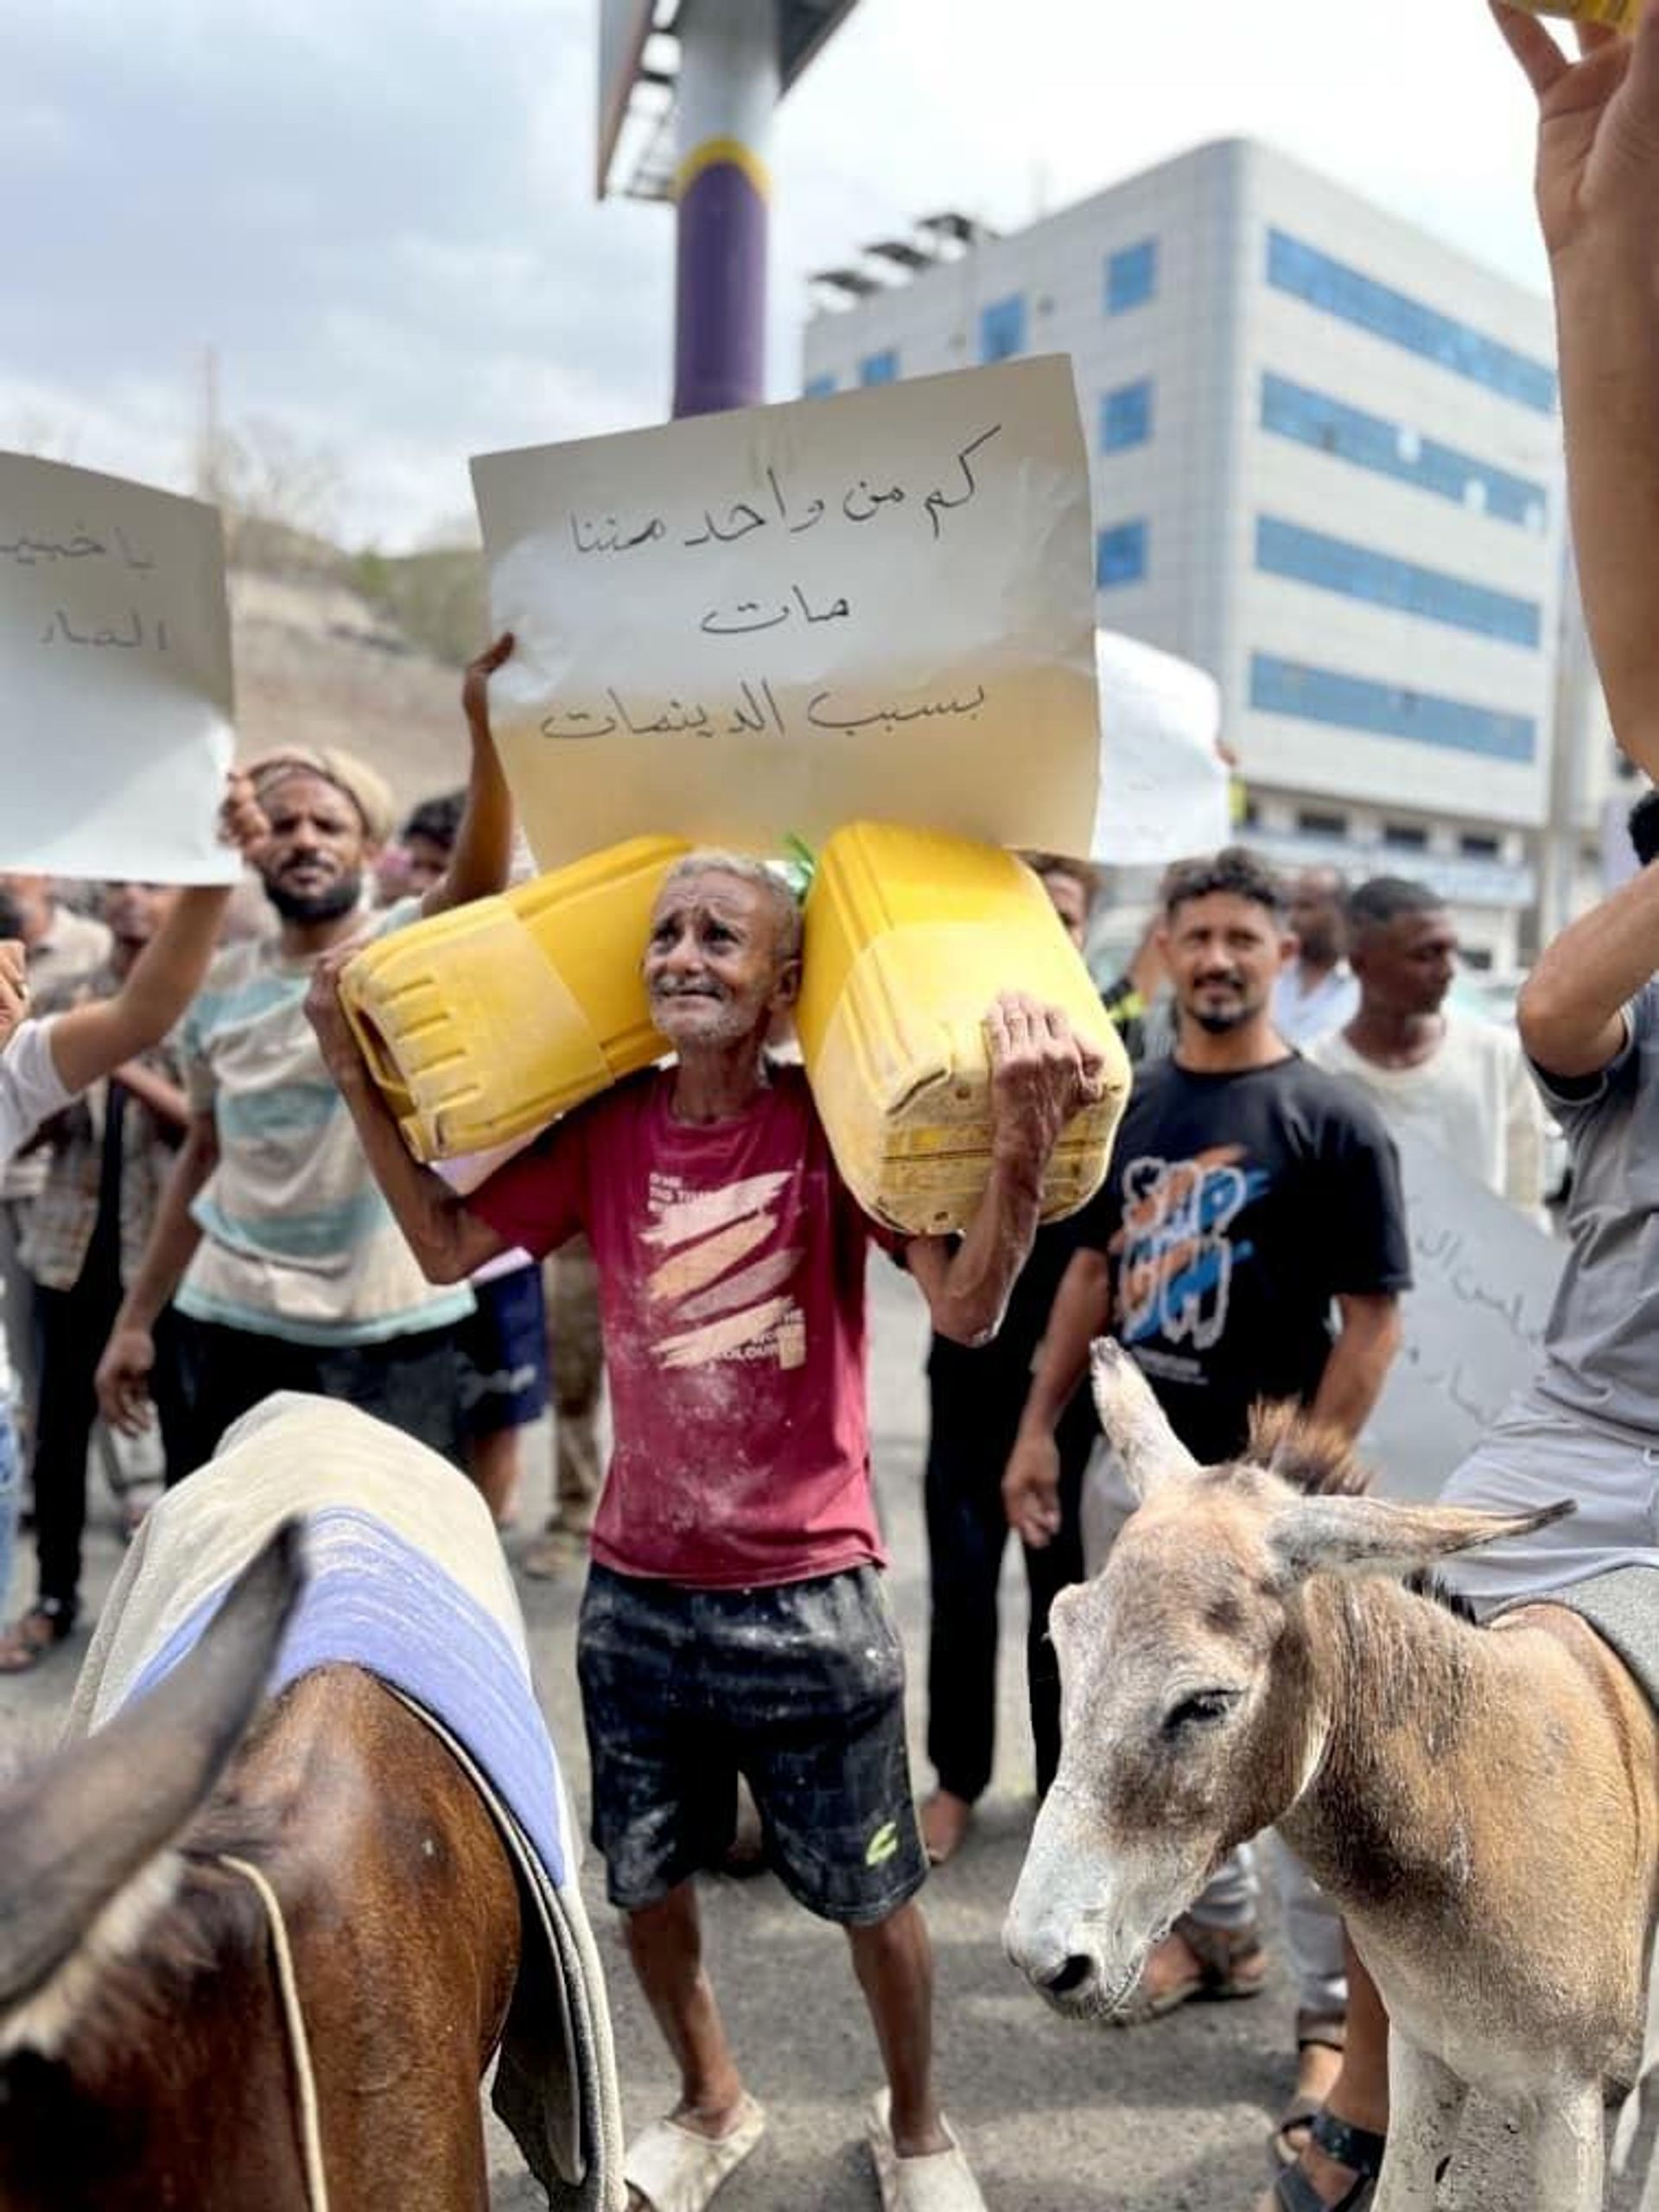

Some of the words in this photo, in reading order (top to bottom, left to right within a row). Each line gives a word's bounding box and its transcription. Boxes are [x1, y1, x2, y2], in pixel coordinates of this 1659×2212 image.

[683, 467, 825, 548] واحد
[842, 480, 906, 523] من
[924, 424, 1002, 540] كم
[700, 584, 850, 635] مات
[807, 684, 985, 740] بسبب
